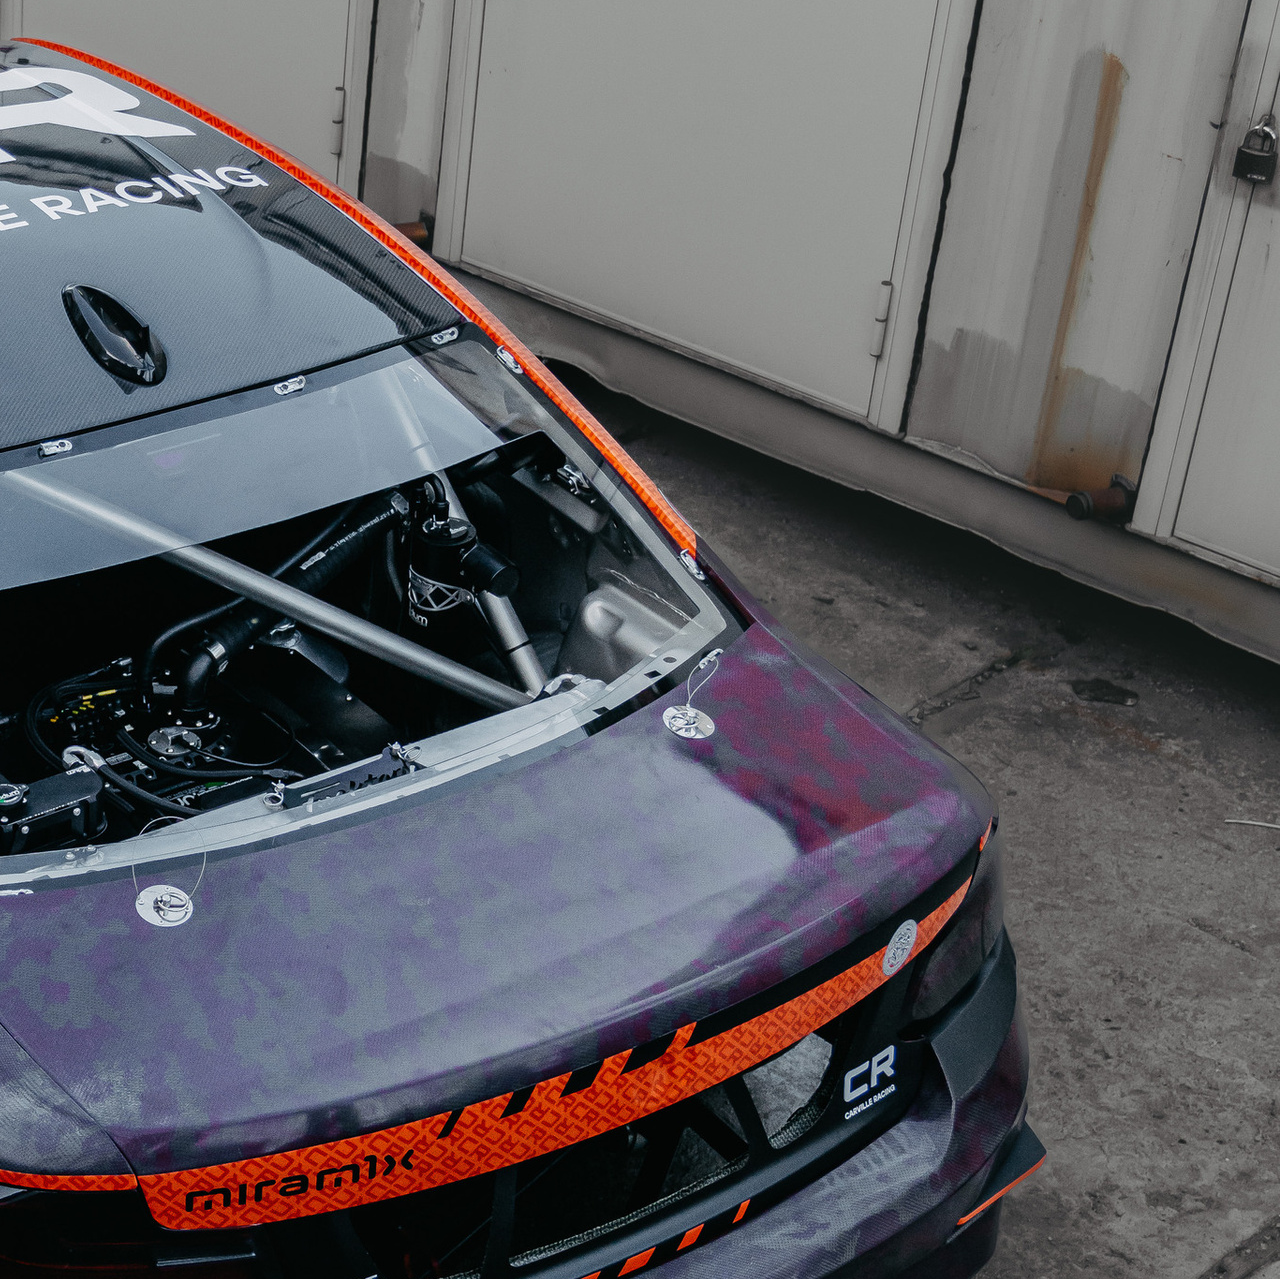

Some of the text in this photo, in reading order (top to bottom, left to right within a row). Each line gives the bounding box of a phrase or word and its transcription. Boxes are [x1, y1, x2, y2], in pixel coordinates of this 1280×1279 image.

[29, 165, 270, 221] RACING
[843, 1044, 895, 1103] CR
[844, 1083, 897, 1120] CARVILLE RACING
